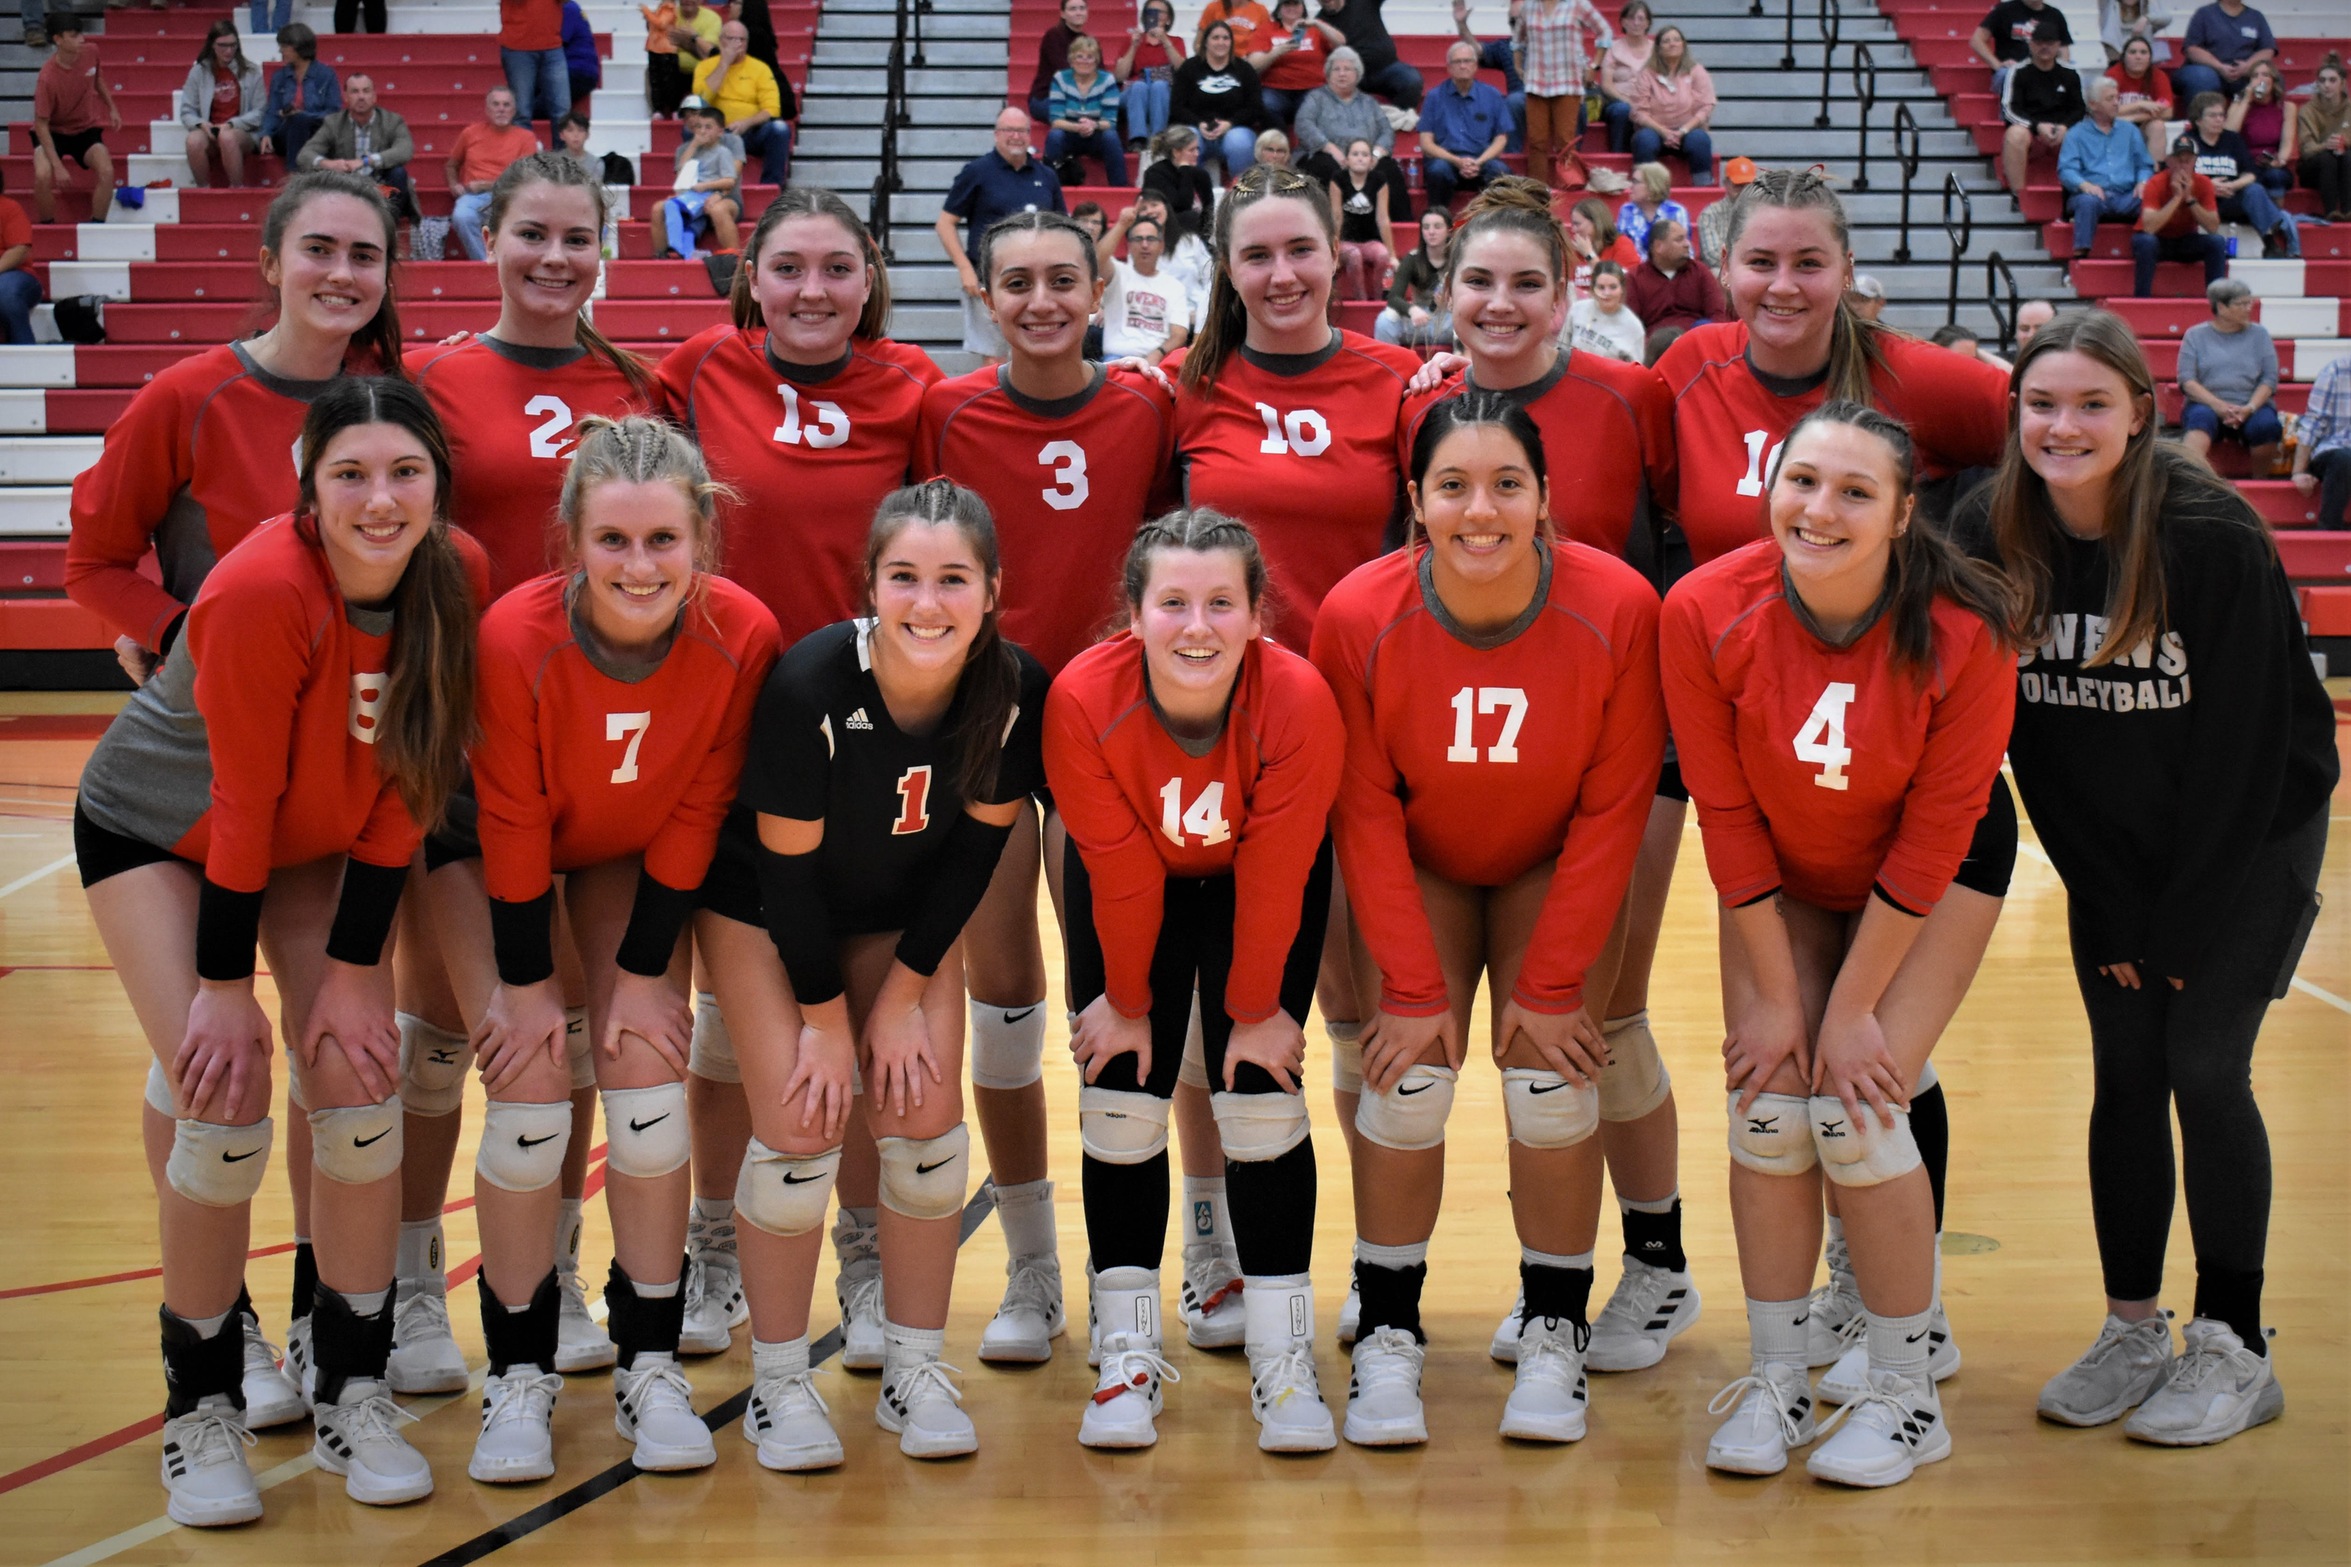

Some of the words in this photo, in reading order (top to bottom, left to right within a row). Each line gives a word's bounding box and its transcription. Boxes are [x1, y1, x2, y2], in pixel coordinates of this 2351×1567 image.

[524, 394, 578, 459] 2
[1255, 402, 1332, 457] 10
[1037, 439, 1089, 511] 3
[1736, 429, 1785, 497] 1
[2018, 613, 2188, 676] WES
[349, 672, 390, 744] 8
[1447, 686, 1529, 763] 17
[2018, 671, 2191, 712] OLLEYBALL
[606, 711, 651, 784] 7
[1792, 681, 1856, 791] 4
[891, 764, 932, 835] 1
[1160, 777, 1231, 847] 14
